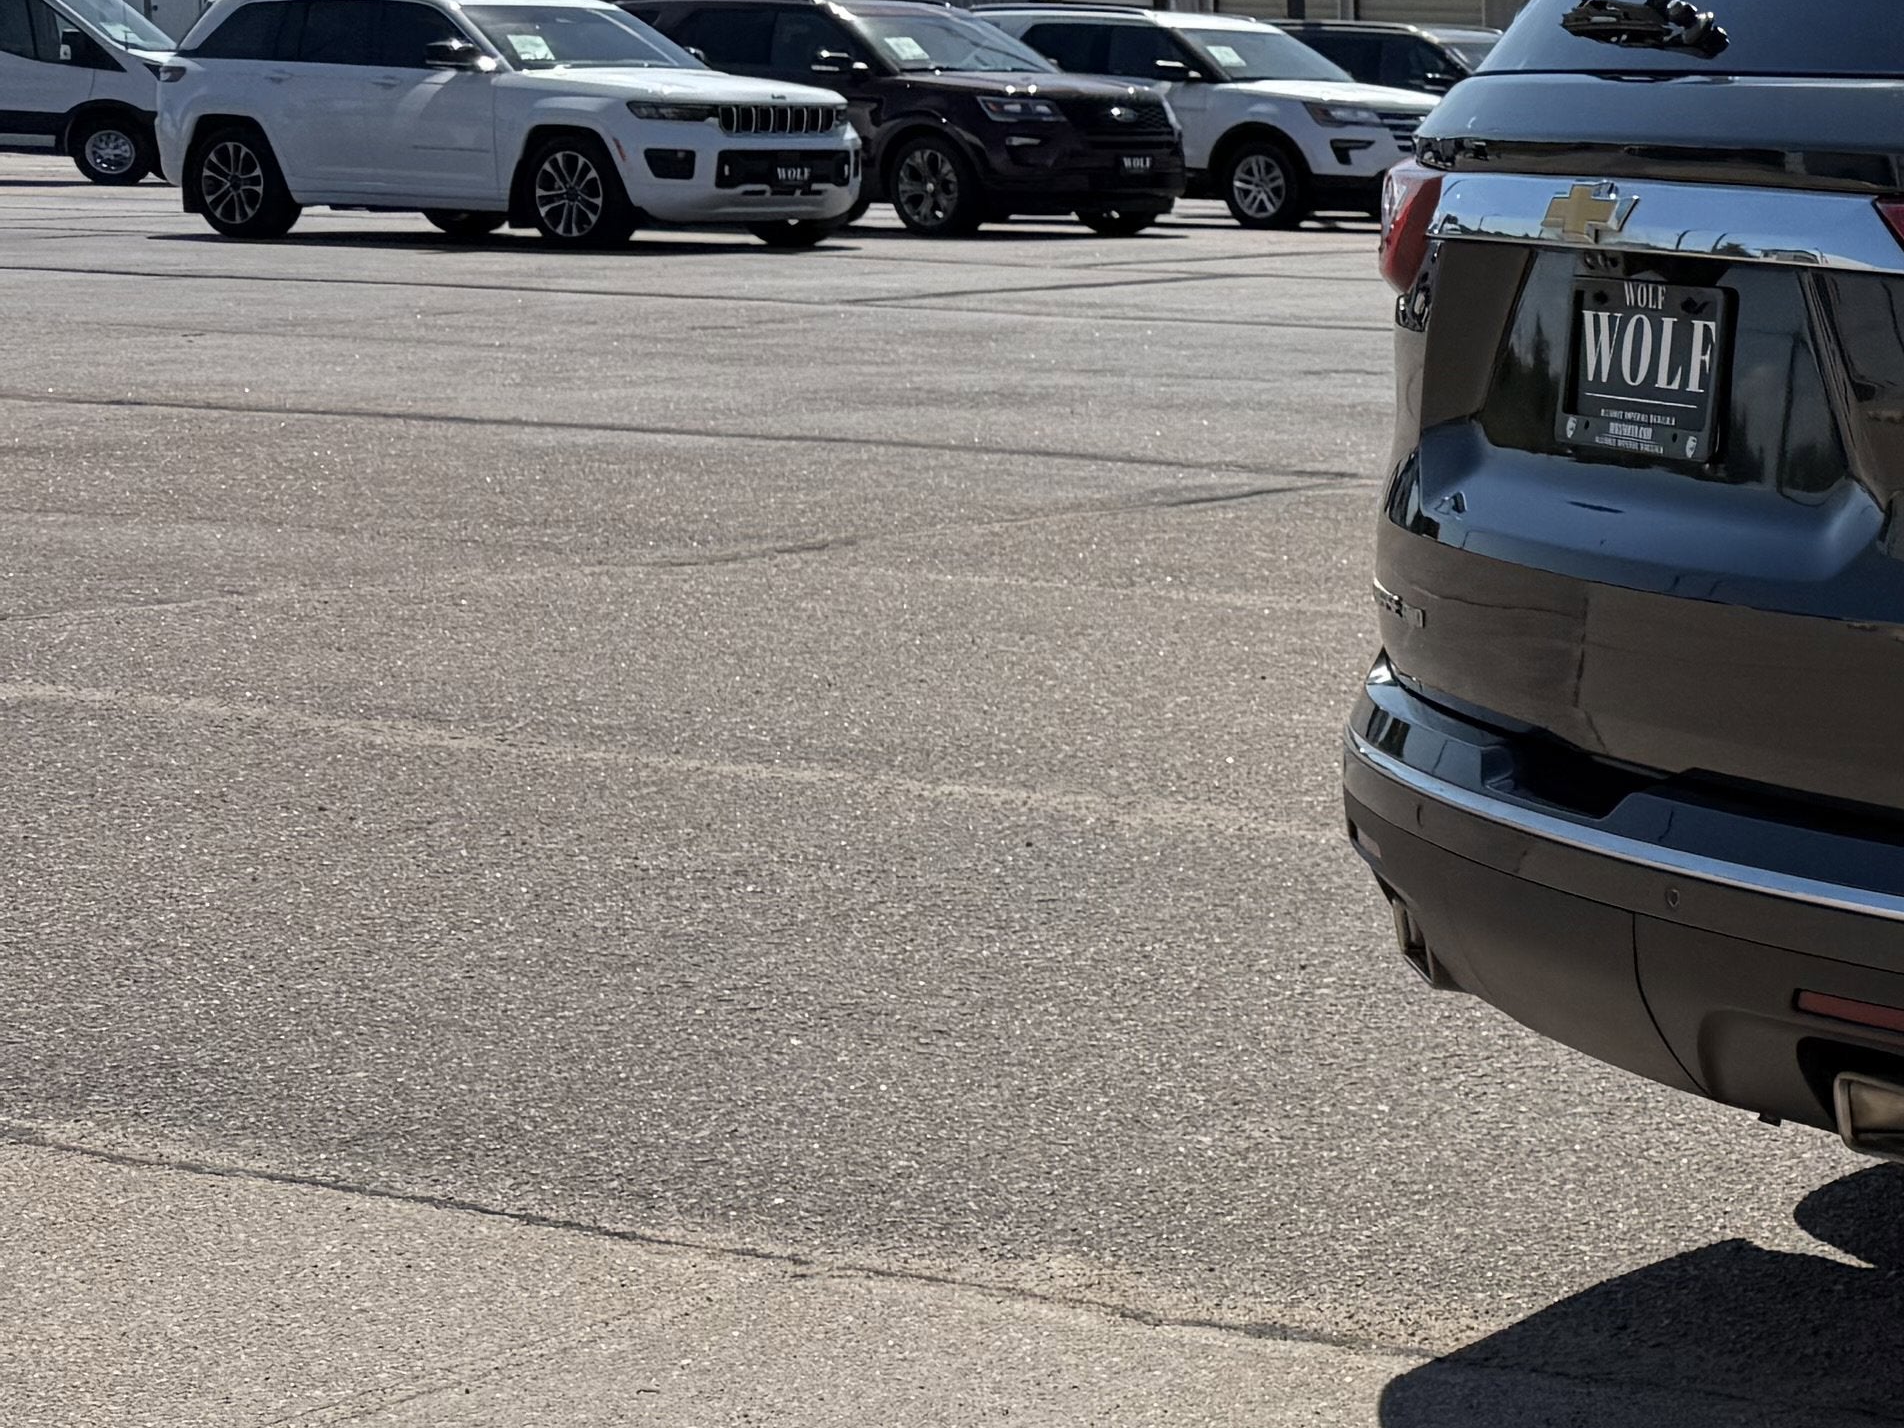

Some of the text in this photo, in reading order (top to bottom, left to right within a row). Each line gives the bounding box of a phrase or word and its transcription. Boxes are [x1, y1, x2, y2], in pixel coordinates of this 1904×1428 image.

[776, 166, 811, 180] WOLF
[1623, 281, 1666, 309] WOLF
[1582, 310, 1716, 393] WOLF
